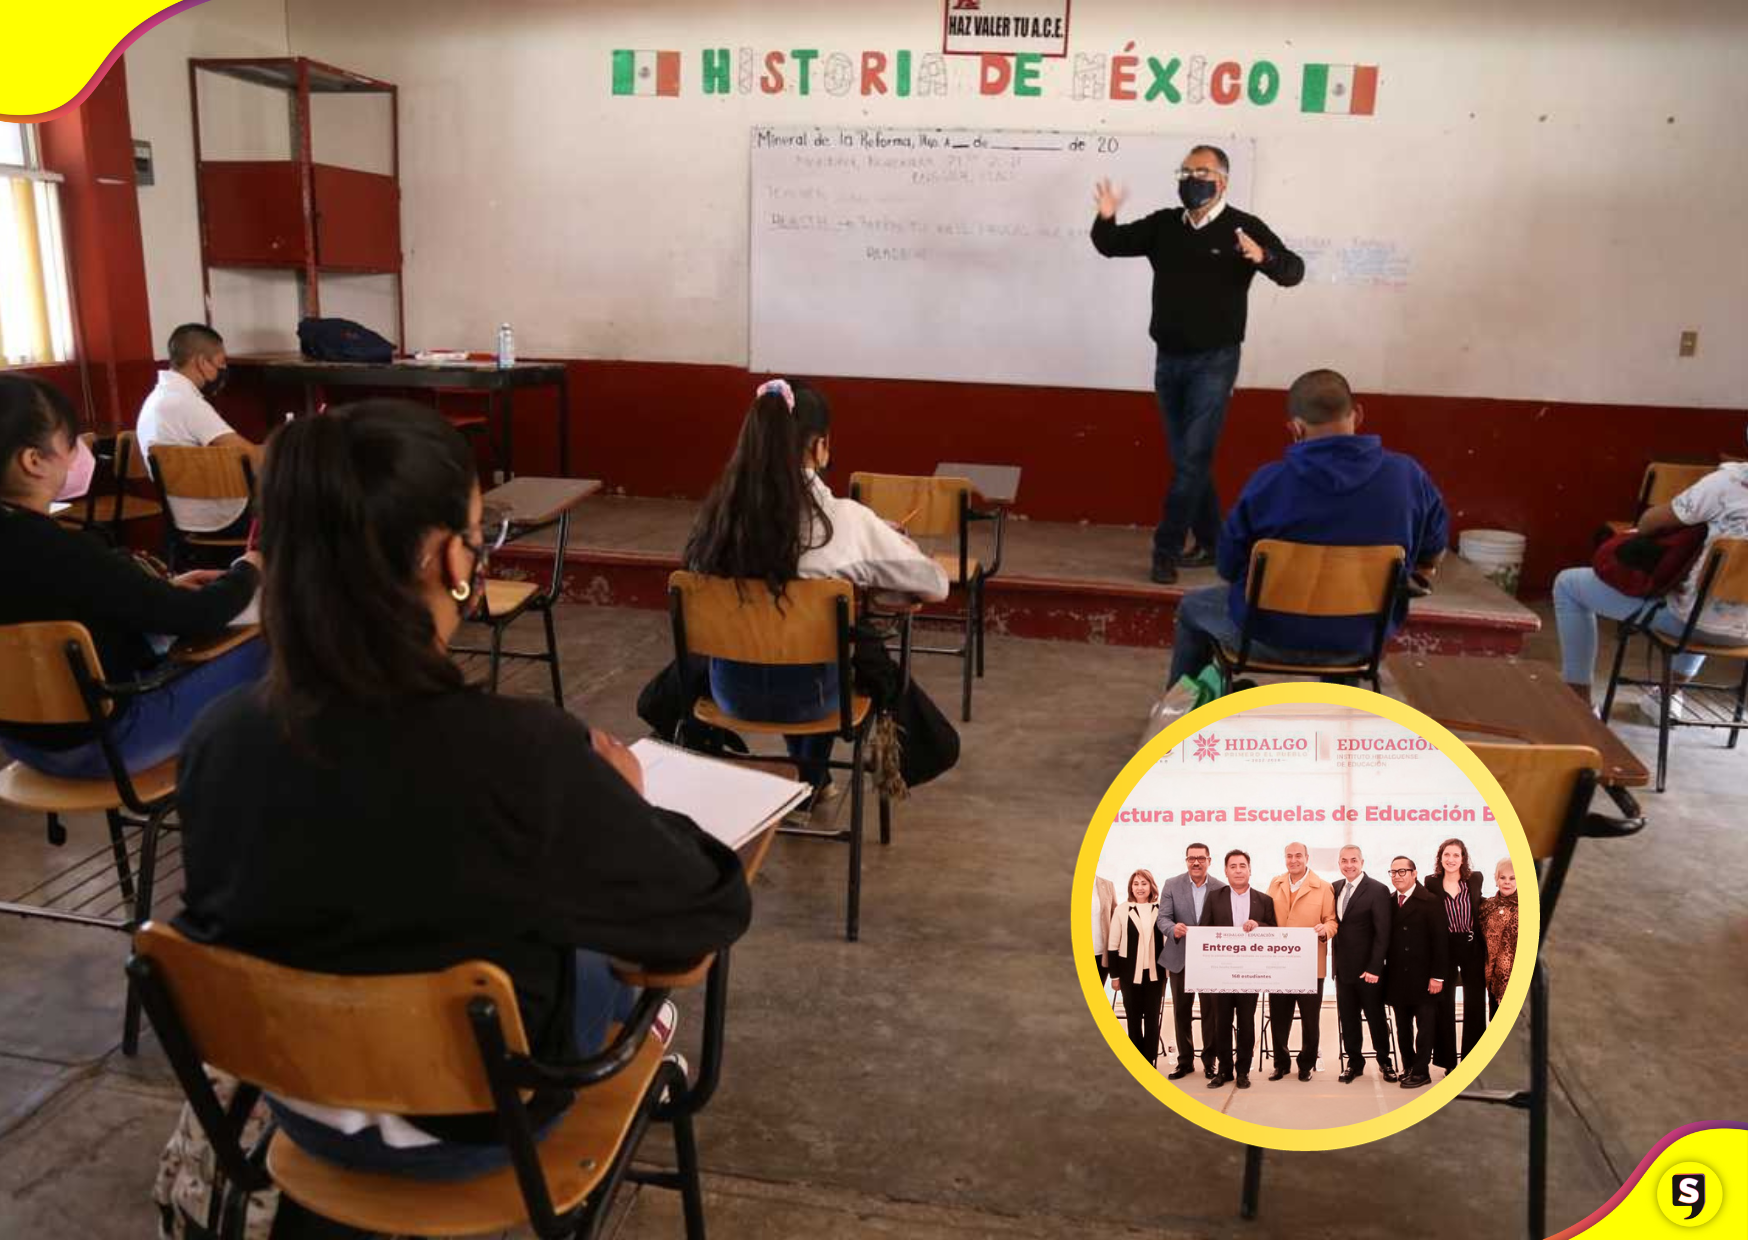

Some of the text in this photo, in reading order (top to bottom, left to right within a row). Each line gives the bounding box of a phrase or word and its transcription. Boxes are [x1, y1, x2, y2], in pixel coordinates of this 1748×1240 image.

[949, 16, 1063, 38] HAZ VALER TU A.C.E.
[702, 41, 1280, 106] HISTORIA DE MÉXICO
[758, 130, 807, 148] Mineral
[814, 134, 831, 147] de
[840, 130, 853, 147] la
[1068, 137, 1086, 151] de
[1097, 136, 1120, 153] 20
[1225, 738, 1308, 751] HIDALGO
[1347, 760, 1387, 768] EDUCACIÓN
[1181, 808, 1227, 826] para
[1234, 805, 1326, 822] Escuelas
[1332, 805, 1359, 822] de
[1365, 805, 1476, 822] Educación
[1202, 943, 1301, 954] Entrega de apoyo
